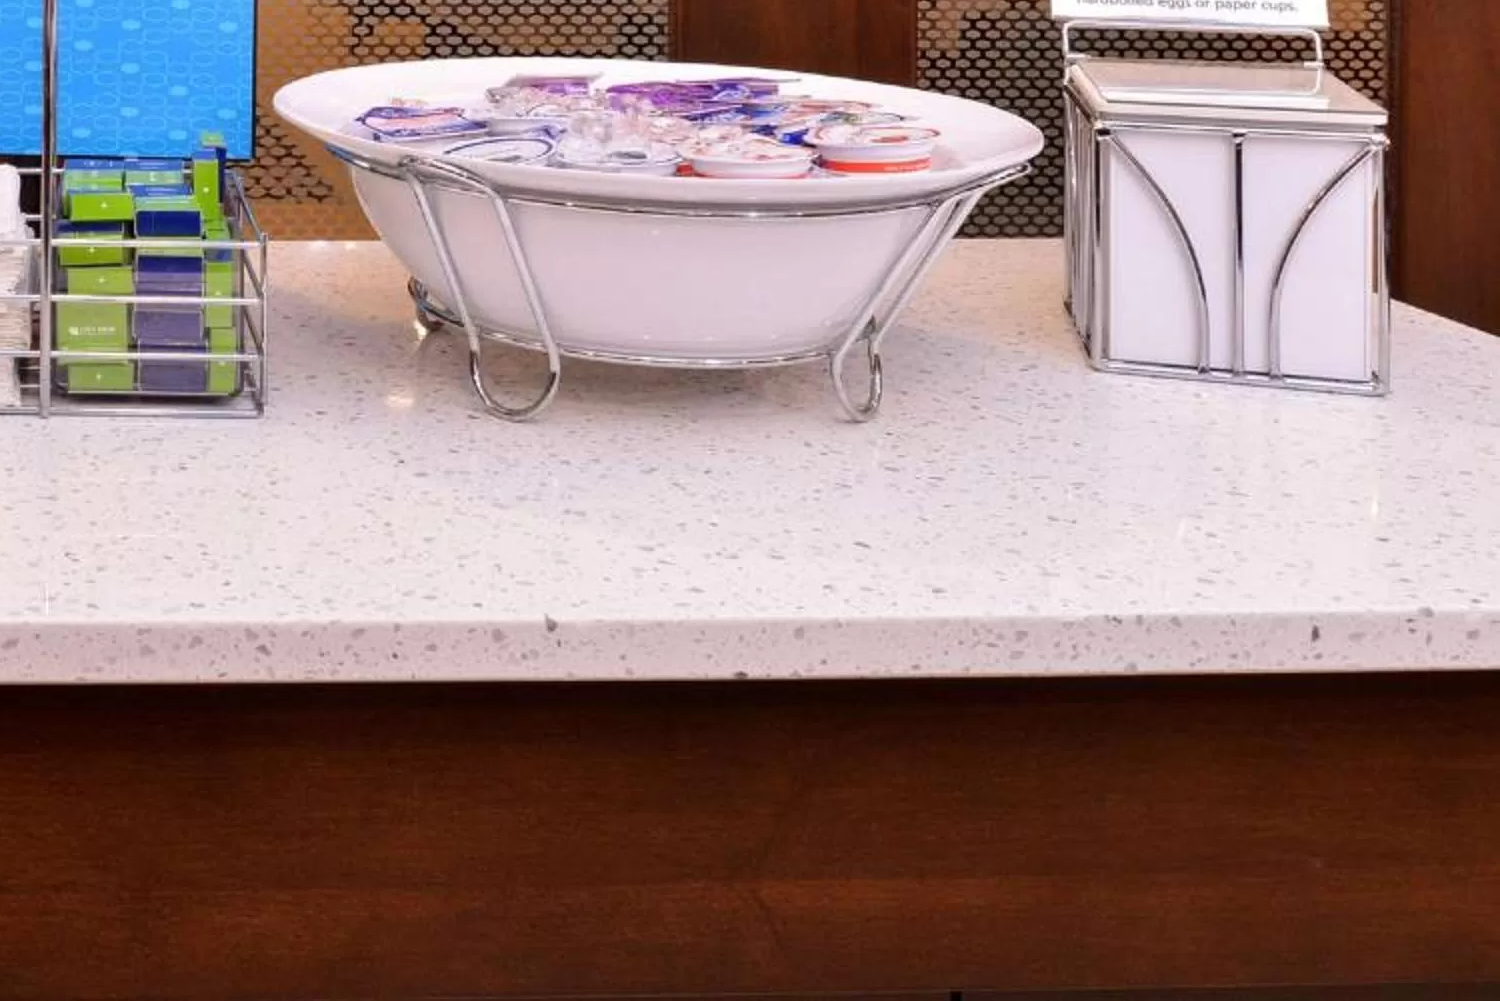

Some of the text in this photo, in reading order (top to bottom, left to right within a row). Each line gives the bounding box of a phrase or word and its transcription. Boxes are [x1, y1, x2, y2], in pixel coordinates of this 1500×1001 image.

[1195, 0, 1209, 9] or
[1215, 0, 1257, 12] paper
[1261, 1, 1298, 13] cups.
